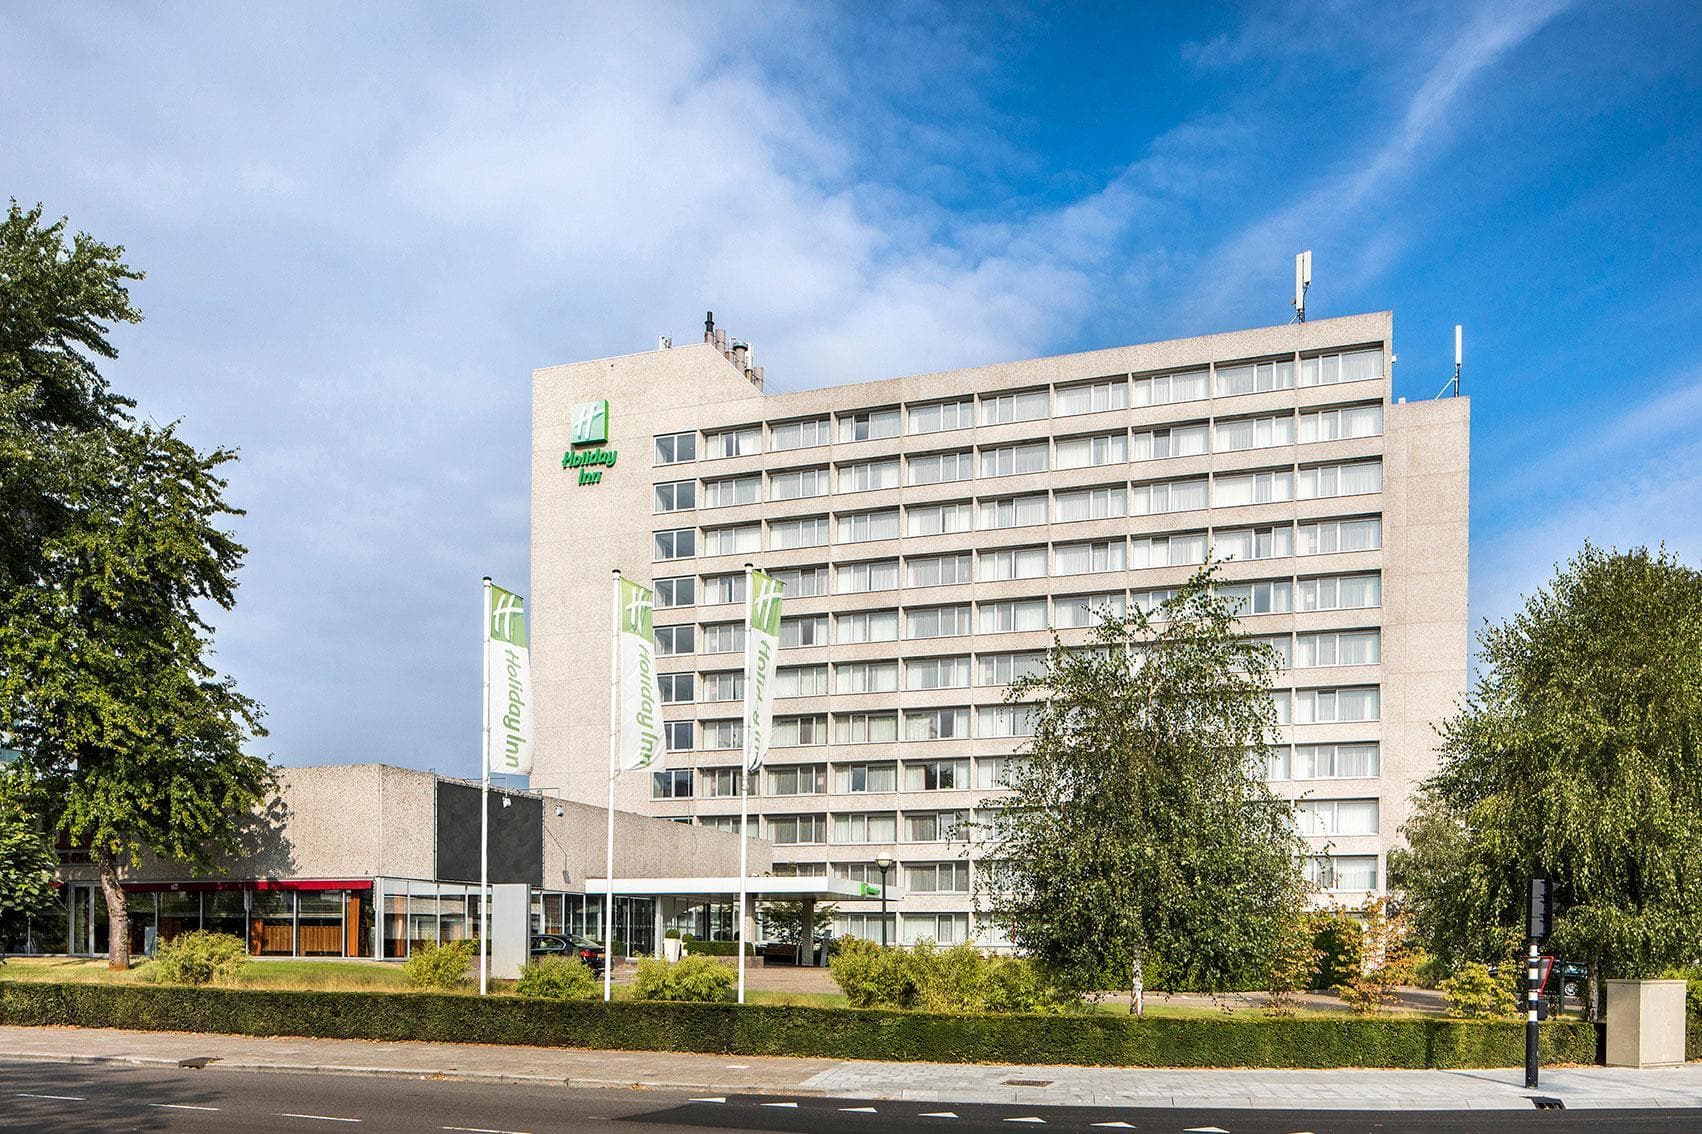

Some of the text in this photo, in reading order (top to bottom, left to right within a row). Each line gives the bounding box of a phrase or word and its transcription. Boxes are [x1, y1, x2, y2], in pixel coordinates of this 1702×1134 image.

[562, 448, 618, 468] Holiday
[578, 467, 603, 486] Inn
[503, 649, 527, 768] Holiday Inn
[636, 644, 655, 729] Holiday
